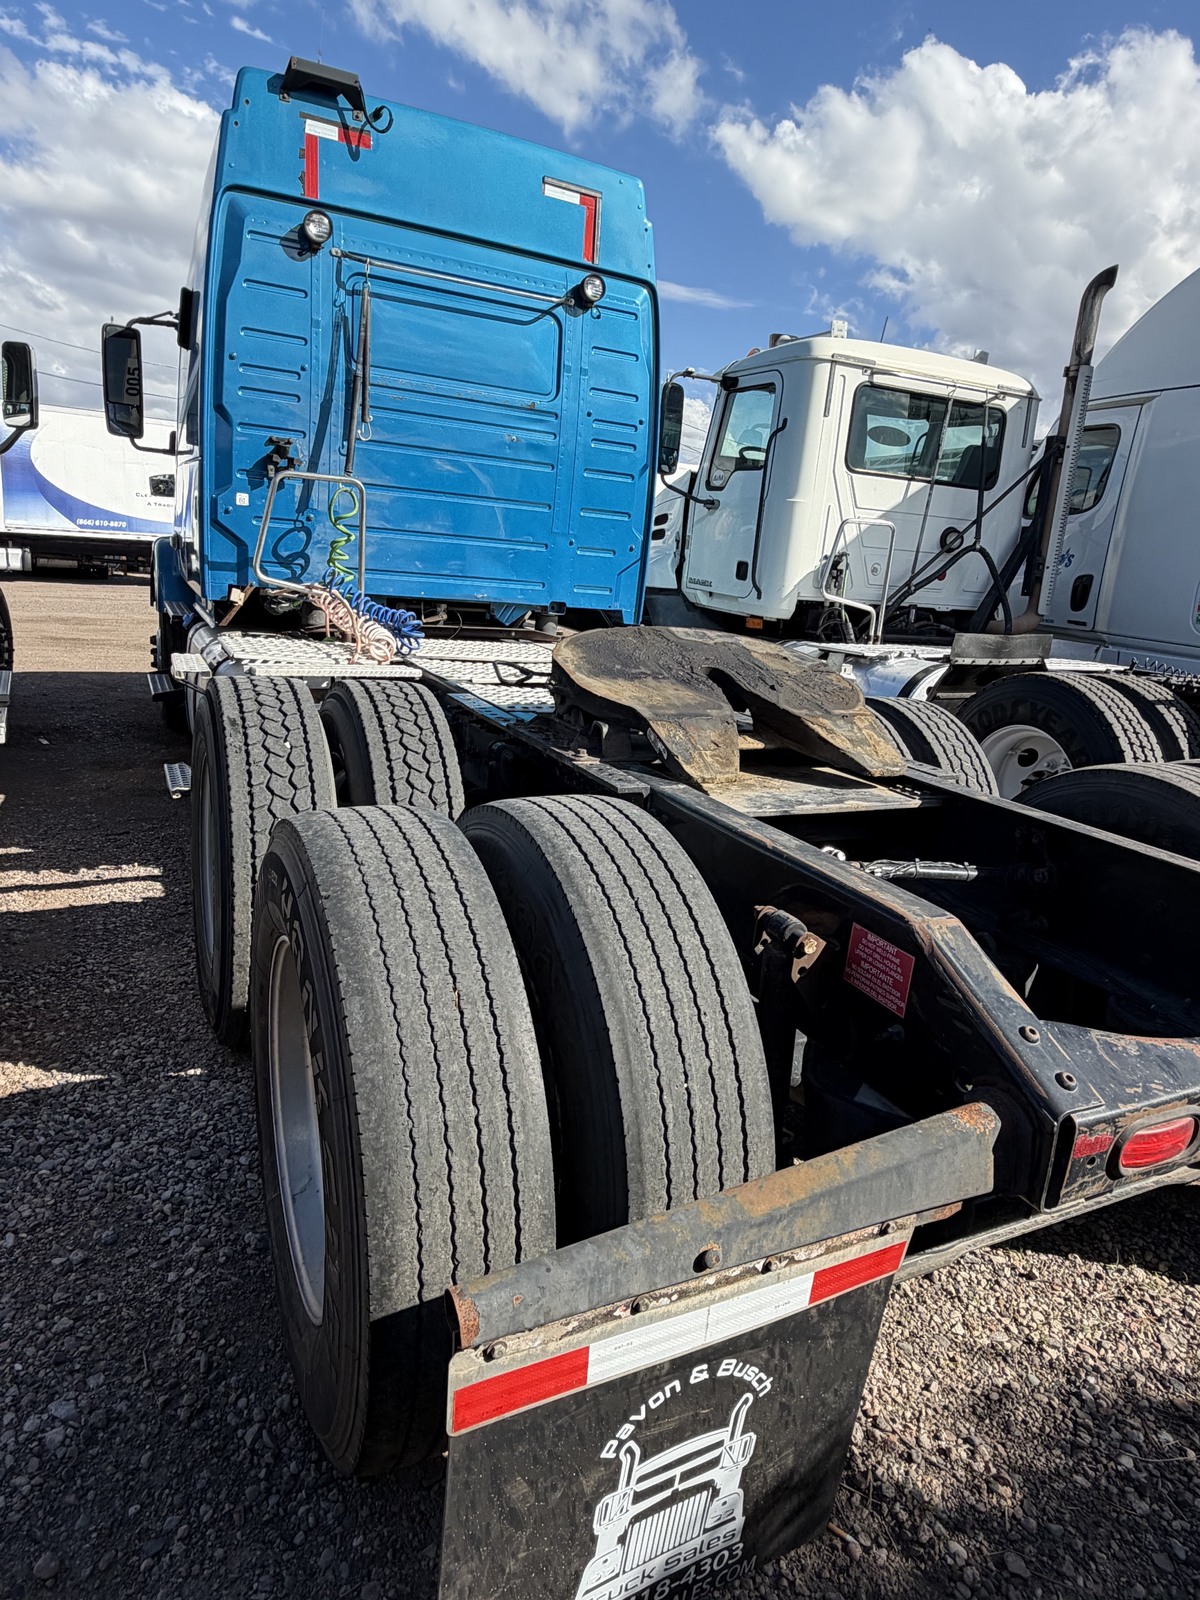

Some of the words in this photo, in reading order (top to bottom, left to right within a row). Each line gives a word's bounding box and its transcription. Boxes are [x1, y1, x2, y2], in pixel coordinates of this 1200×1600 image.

[76, 518, 94, 526] (866)
[688, 577, 713, 588] MACK
[600, 1379, 681, 1459] Pavon
[689, 1363, 709, 1384] &
[716, 1358, 774, 1398] Busch
[663, 1528, 737, 1572] Sales
